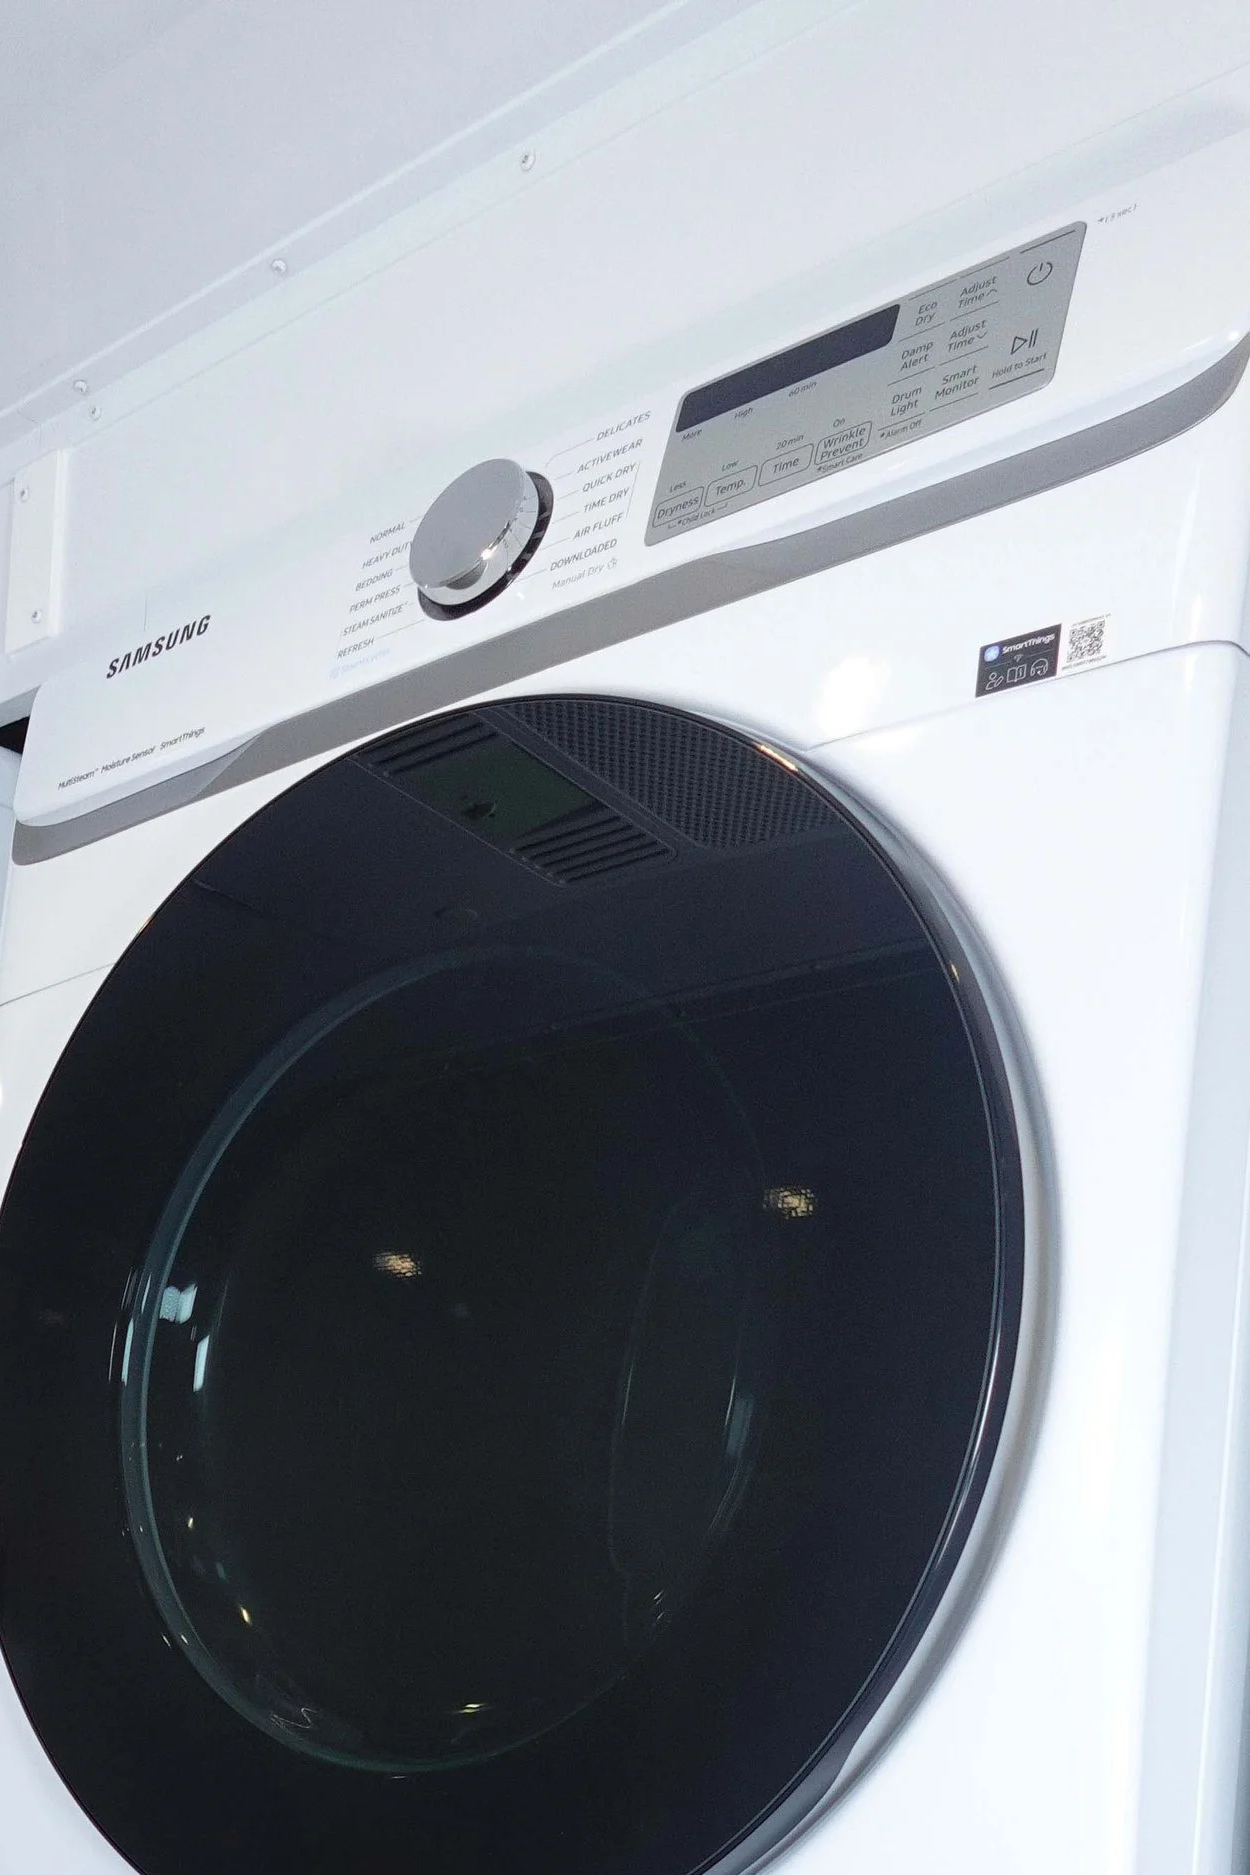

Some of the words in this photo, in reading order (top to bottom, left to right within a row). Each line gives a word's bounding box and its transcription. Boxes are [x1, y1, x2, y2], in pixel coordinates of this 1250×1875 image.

[960, 275, 998, 297] Adjust
[918, 301, 938, 315] Eco
[958, 293, 985, 309] Time
[915, 311, 936, 326] Dry
[949, 319, 987, 340] Adjust
[901, 342, 934, 360] Damp
[948, 336, 975, 352] Time
[900, 353, 929, 371] Alert
[991, 363, 1013, 379] Hold
[1013, 360, 1024, 370] to
[1024, 352, 1048, 366] Start
[941, 364, 978, 386] Smart
[892, 386, 922, 404] Drum
[934, 376, 980, 400] Monitor
[734, 406, 754, 420] High
[890, 398, 919, 417] Light
[596, 410, 652, 441] DELICATES
[833, 417, 846, 428] On
[909, 418, 922, 431] Off
[681, 428, 702, 442] More
[822, 427, 867, 449] Wrinkle
[577, 438, 643, 473] ACTIVEWEAR
[820, 439, 865, 461] Prevent
[845, 453, 863, 465] Care
[721, 460, 739, 472] Low
[772, 457, 800, 474] Time
[582, 473, 613, 493] QUICK
[615, 462, 637, 479] DRY
[669, 480, 687, 493] Less
[715, 478, 747, 496] Temp.
[583, 498, 607, 513] TIME
[608, 487, 631, 502] DRY
[657, 494, 699, 520] Dryness
[700, 508, 715, 520] Lock
[370, 522, 405, 544] NORMAL
[573, 525, 591, 540] AIR
[592, 512, 625, 532] FLUFF
[362, 551, 390, 569] HEAVY
[391, 541, 411, 556] DUT
[550, 538, 618, 572] DOWNLOADED
[355, 568, 393, 591] BEDDING
[551, 569, 586, 590] Manual
[587, 563, 605, 577] Dry
[349, 597, 372, 613] PERM
[374, 585, 401, 601] PRESS
[343, 618, 369, 636] STEAM
[106, 615, 211, 679] SAMSUNG
[337, 637, 375, 659] REFRESH
[1002, 633, 1056, 654] SmartThings
[101, 757, 130, 773] Moisture
[131, 746, 156, 761] Sensor
[160, 727, 205, 750] SmartThings
